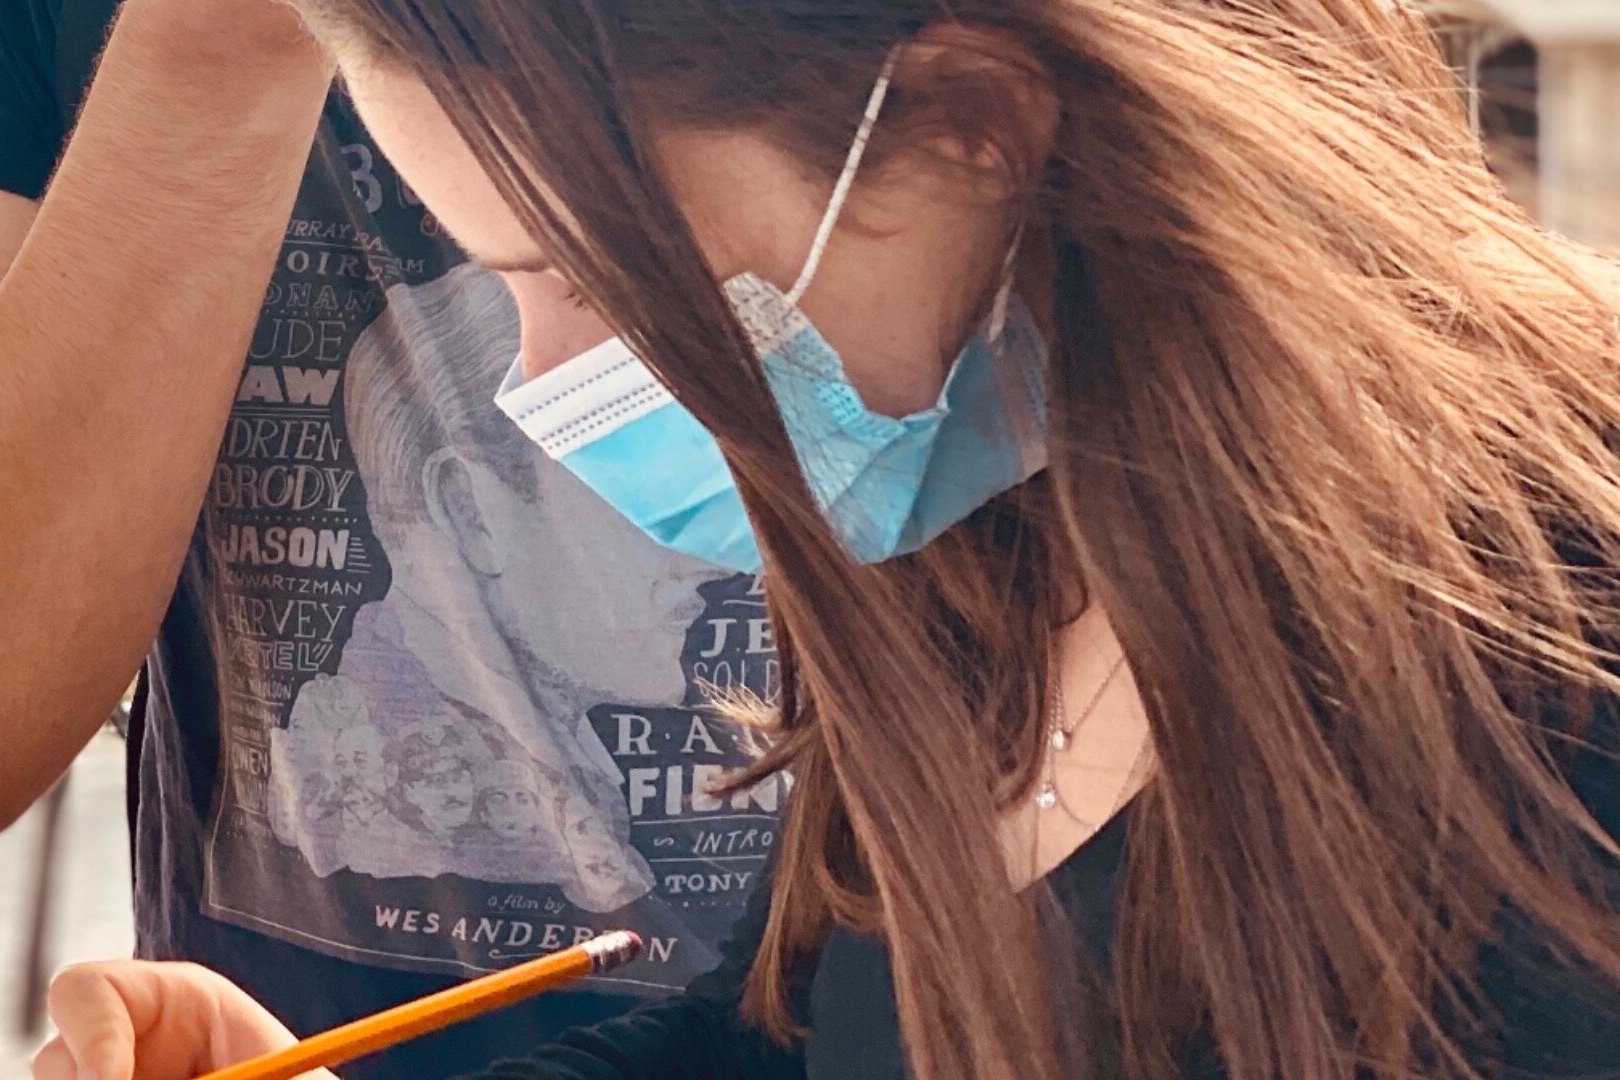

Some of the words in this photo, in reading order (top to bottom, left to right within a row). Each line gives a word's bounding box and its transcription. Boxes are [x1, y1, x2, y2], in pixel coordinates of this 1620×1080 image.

[249, 318, 347, 363] UDE
[237, 365, 342, 407] AW
[225, 418, 343, 462] DRIEN
[214, 463, 356, 513] BRODY
[222, 523, 350, 571] JASON
[628, 763, 783, 817] FIEN
[691, 829, 774, 854] INTRO
[487, 894, 498, 907] a
[499, 893, 539, 911] film
[544, 896, 566, 915] by
[664, 871, 753, 894] TONY
[375, 905, 440, 934] WES
[450, 915, 679, 964] ANDERN
